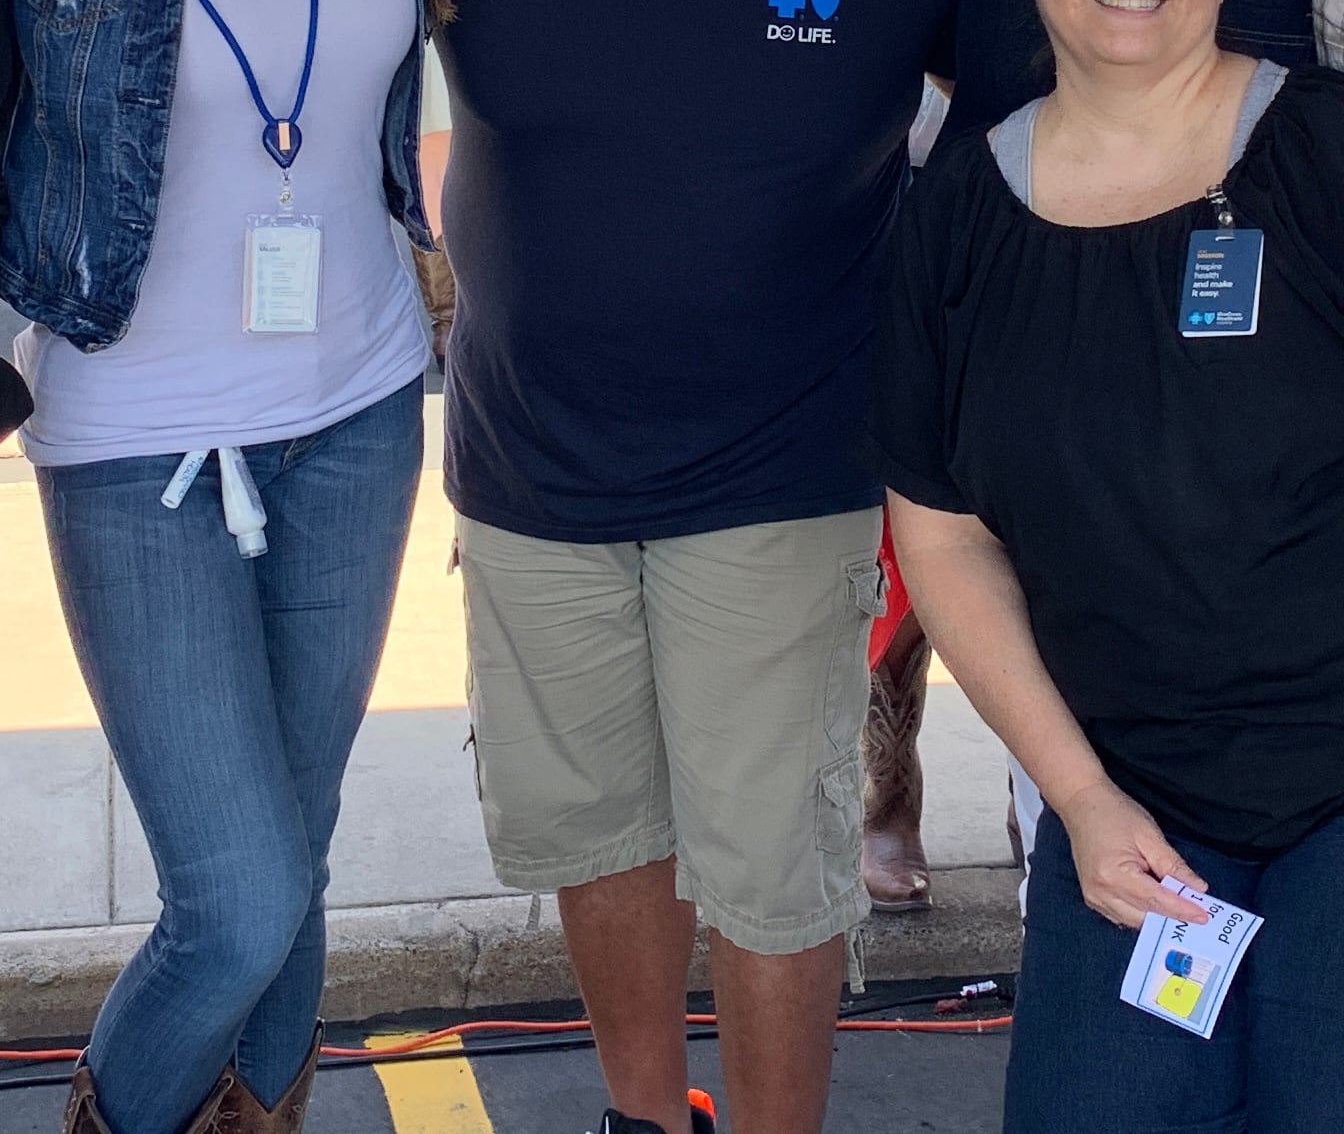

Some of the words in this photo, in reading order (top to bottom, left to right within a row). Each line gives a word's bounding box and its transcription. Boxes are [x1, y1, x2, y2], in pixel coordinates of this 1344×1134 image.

[798, 26, 837, 44] LIFE.
[1192, 280, 1210, 288] and
[1210, 280, 1234, 288] make
[1206, 902, 1225, 919] for
[1171, 920, 1189, 943] NK
[1218, 913, 1244, 945] Good
